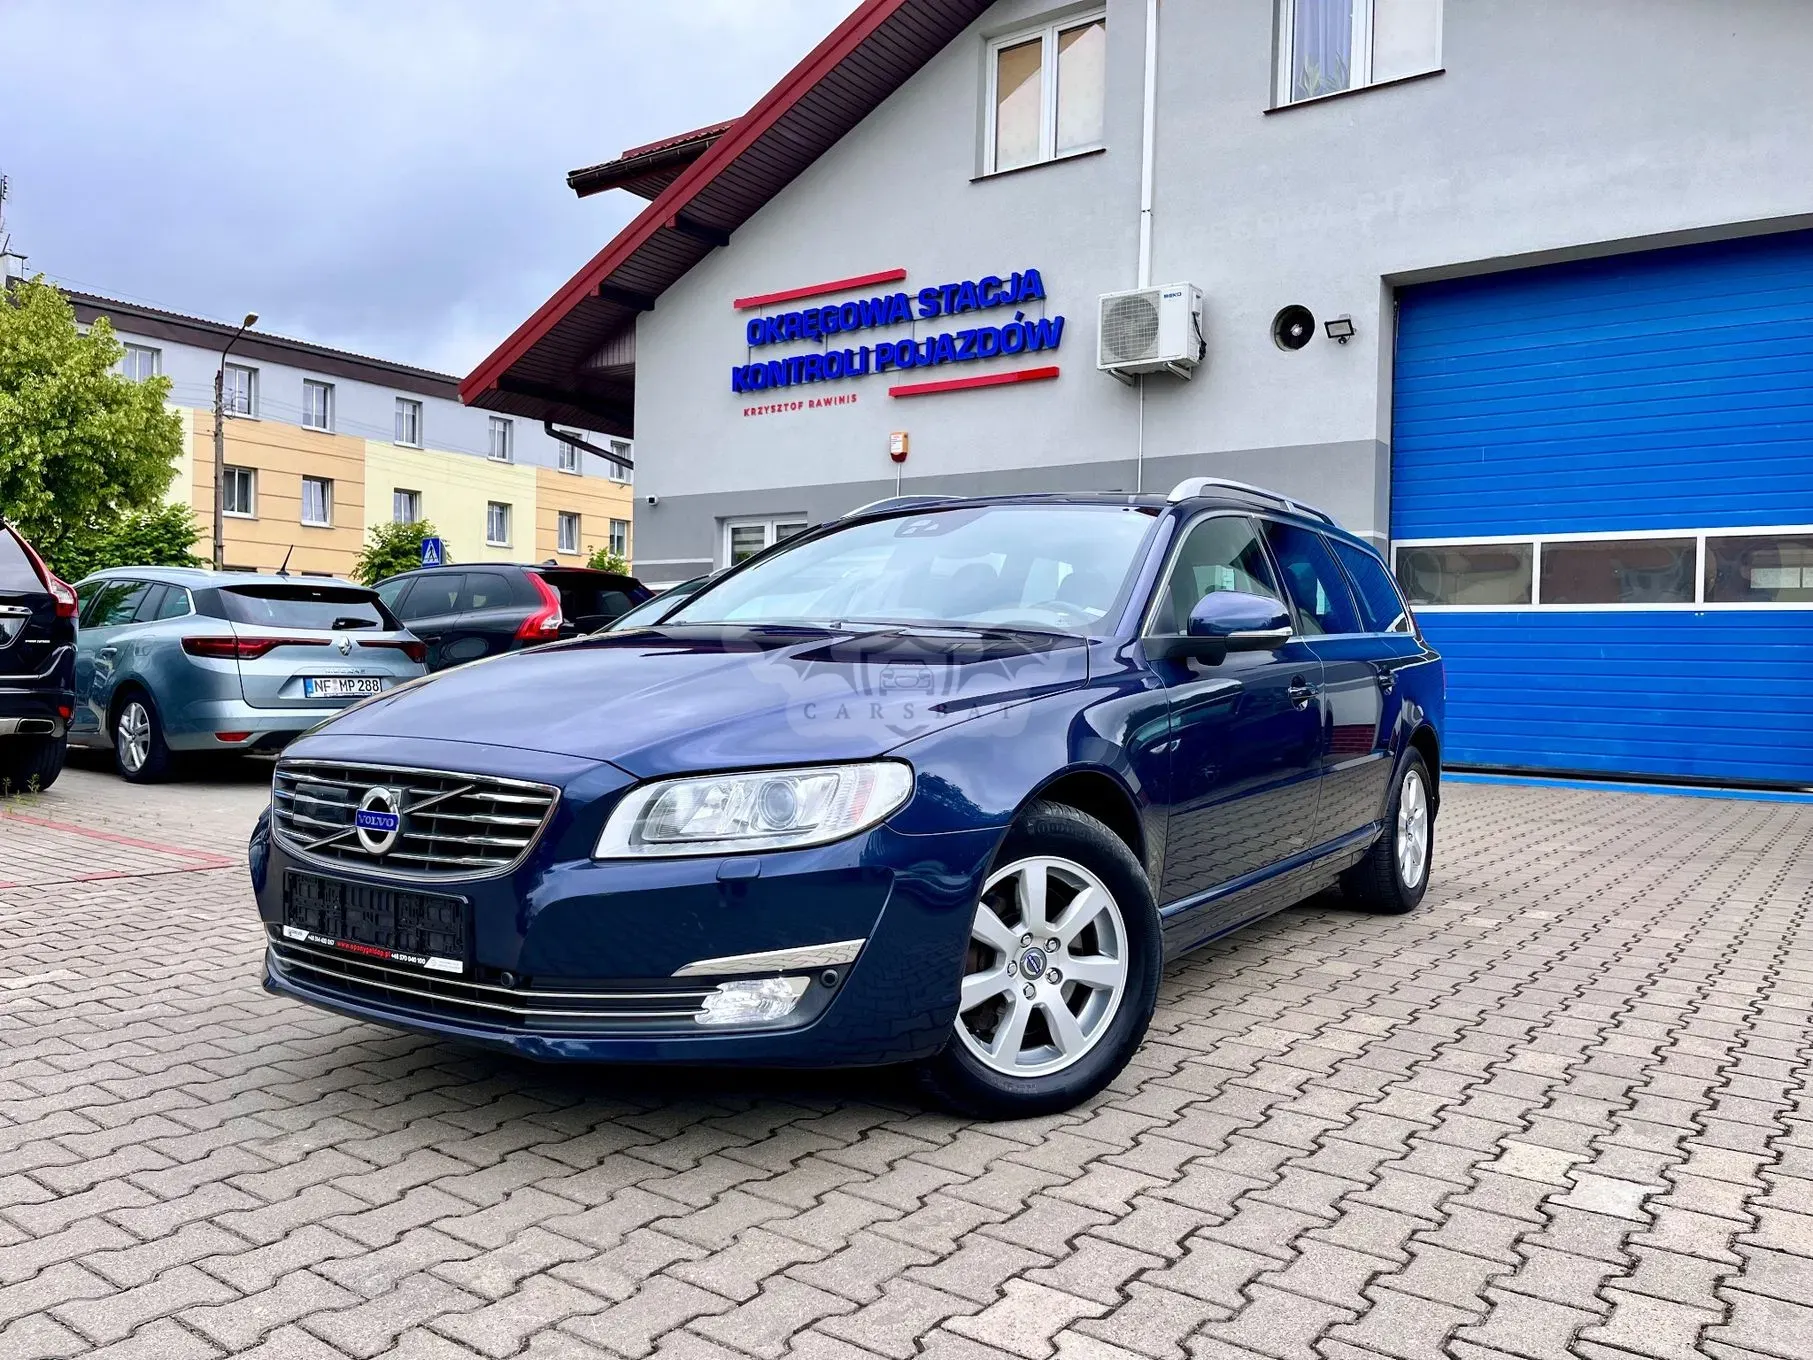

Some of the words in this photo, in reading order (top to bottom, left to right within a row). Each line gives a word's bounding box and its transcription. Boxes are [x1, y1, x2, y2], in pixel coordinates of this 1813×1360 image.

[747, 292, 914, 347] OKRĘGOWA
[918, 268, 1046, 318] STACJA
[732, 345, 870, 393] KONTROLI
[875, 310, 1065, 372] POJAZDÓW
[743, 401, 804, 417] KRZYSZTOF
[808, 393, 858, 409] RAWINIS
[314, 679, 331, 692] NF
[339, 679, 355, 692] MP
[357, 679, 380, 692] 288
[358, 814, 395, 827] VOLVO
